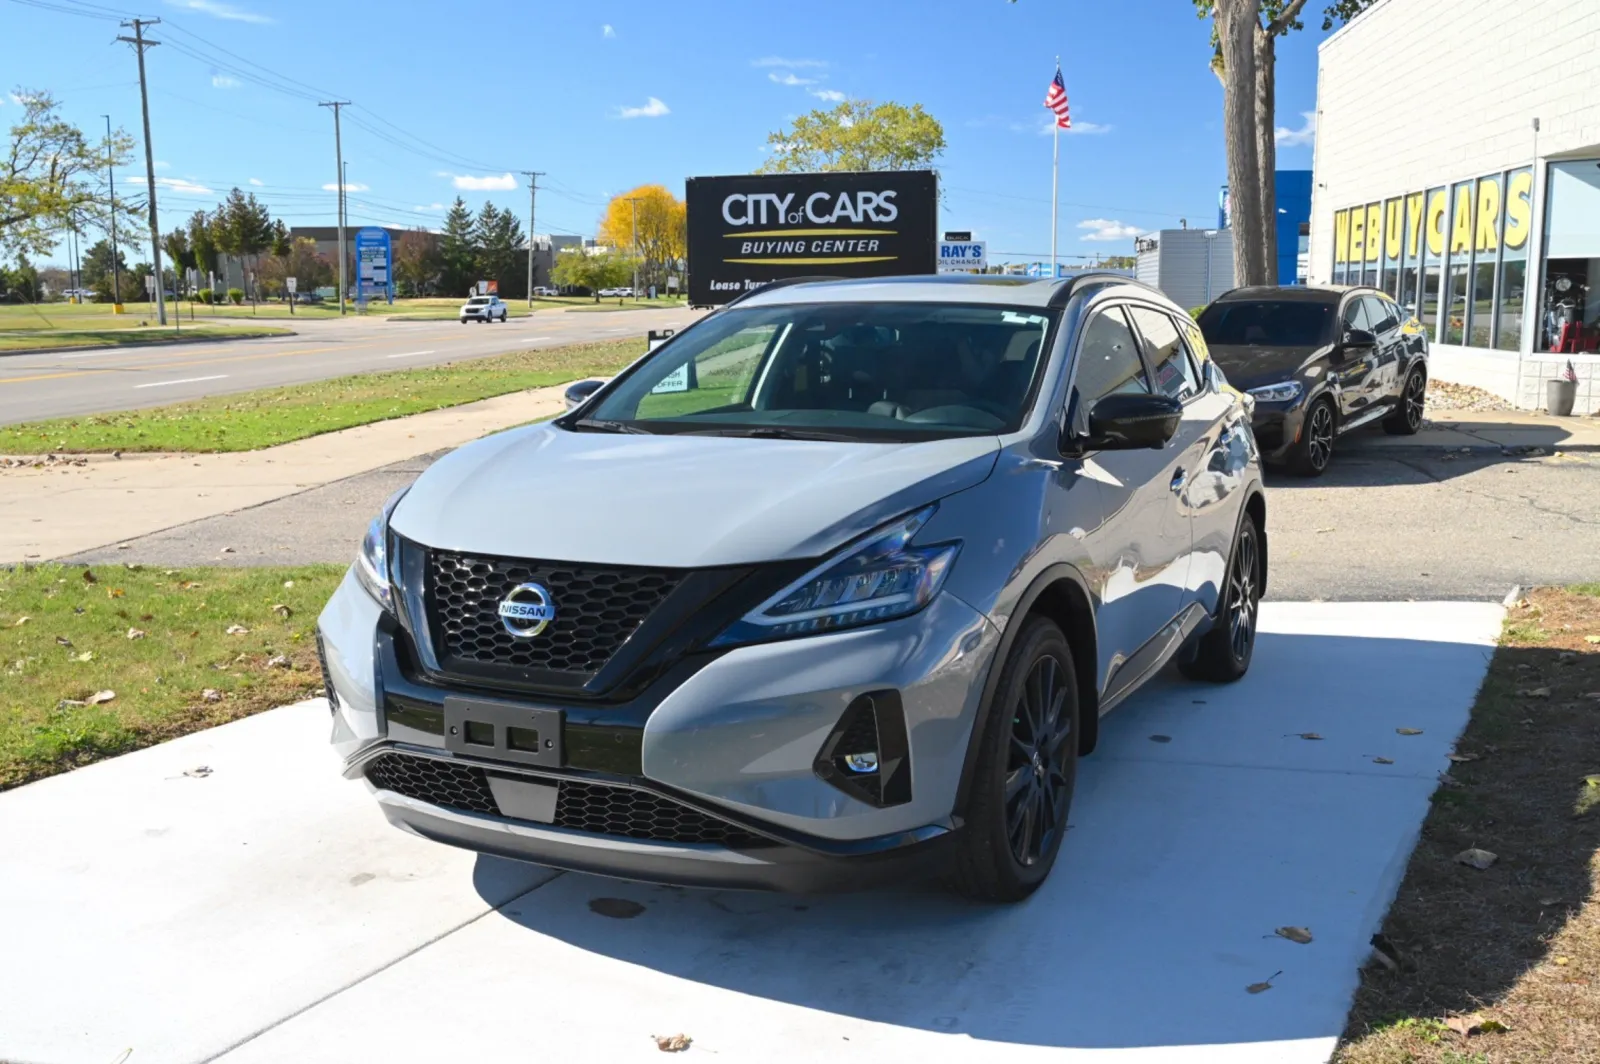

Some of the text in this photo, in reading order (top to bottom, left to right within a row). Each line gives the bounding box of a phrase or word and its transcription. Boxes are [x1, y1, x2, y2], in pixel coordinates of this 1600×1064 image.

[722, 190, 898, 226] CITY of CARS
[741, 240, 880, 254] BUYING CENTER
[941, 244, 982, 258] RAY'S
[710, 279, 741, 291] Lease
[501, 604, 546, 617] NISSAN
